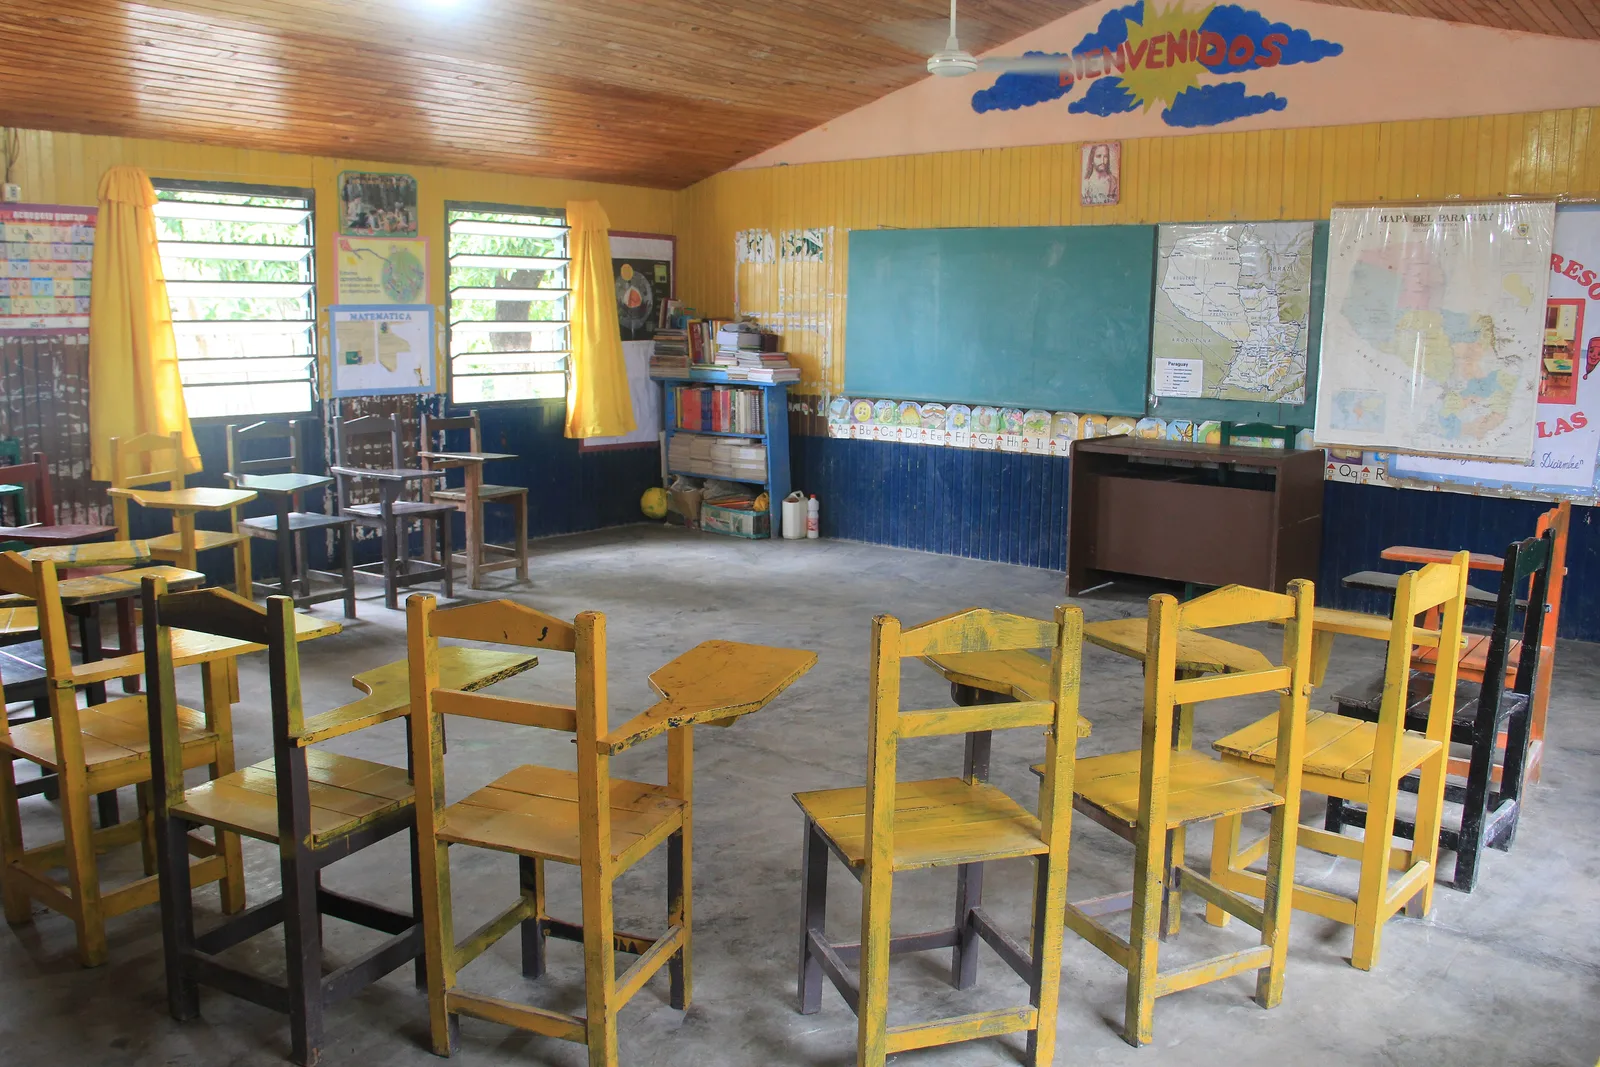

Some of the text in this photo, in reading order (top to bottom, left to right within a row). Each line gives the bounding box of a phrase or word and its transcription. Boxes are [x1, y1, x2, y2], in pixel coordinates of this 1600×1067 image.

[1059, 28, 1289, 88] BIENVENIDOS
[1378, 214, 1409, 223] MAPA
[1413, 214, 1435, 223] DEL
[349, 312, 412, 321] MATEMATICA
[859, 424, 871, 435] Bb
[880, 426, 894, 437] Cc
[905, 428, 918, 439] Dd
[930, 430, 942, 440] Ee
[978, 433, 994, 450] Gg
[1006, 435, 1019, 447] Hh
[1339, 464, 1358, 484] Qq
